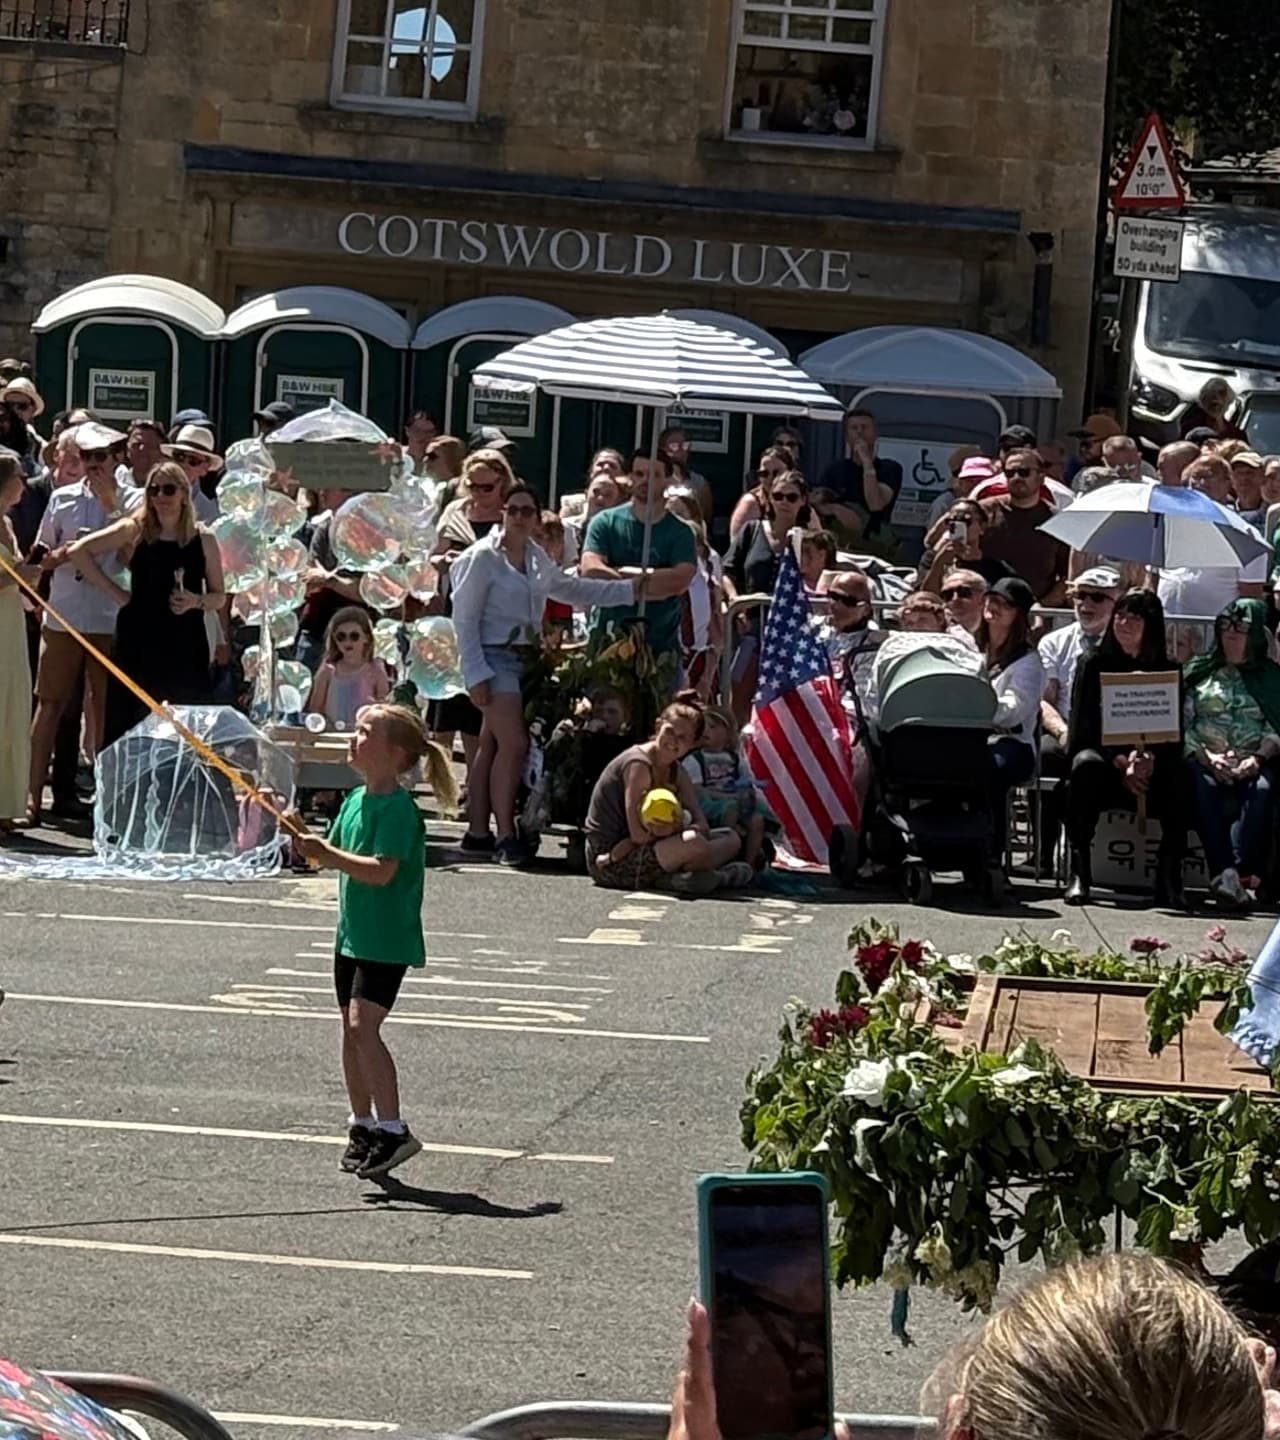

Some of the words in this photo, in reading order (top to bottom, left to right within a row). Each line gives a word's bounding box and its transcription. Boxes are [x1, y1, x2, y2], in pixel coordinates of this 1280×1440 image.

[1137, 162, 1165, 177] 3.0m
[1122, 222, 1178, 242] Overhanging
[339, 212, 673, 278] COTSWOLD
[693, 239, 852, 293] LUXE
[1130, 240, 1167, 257] building
[1117, 257, 1131, 271] 50
[1149, 261, 1177, 275] ahead
